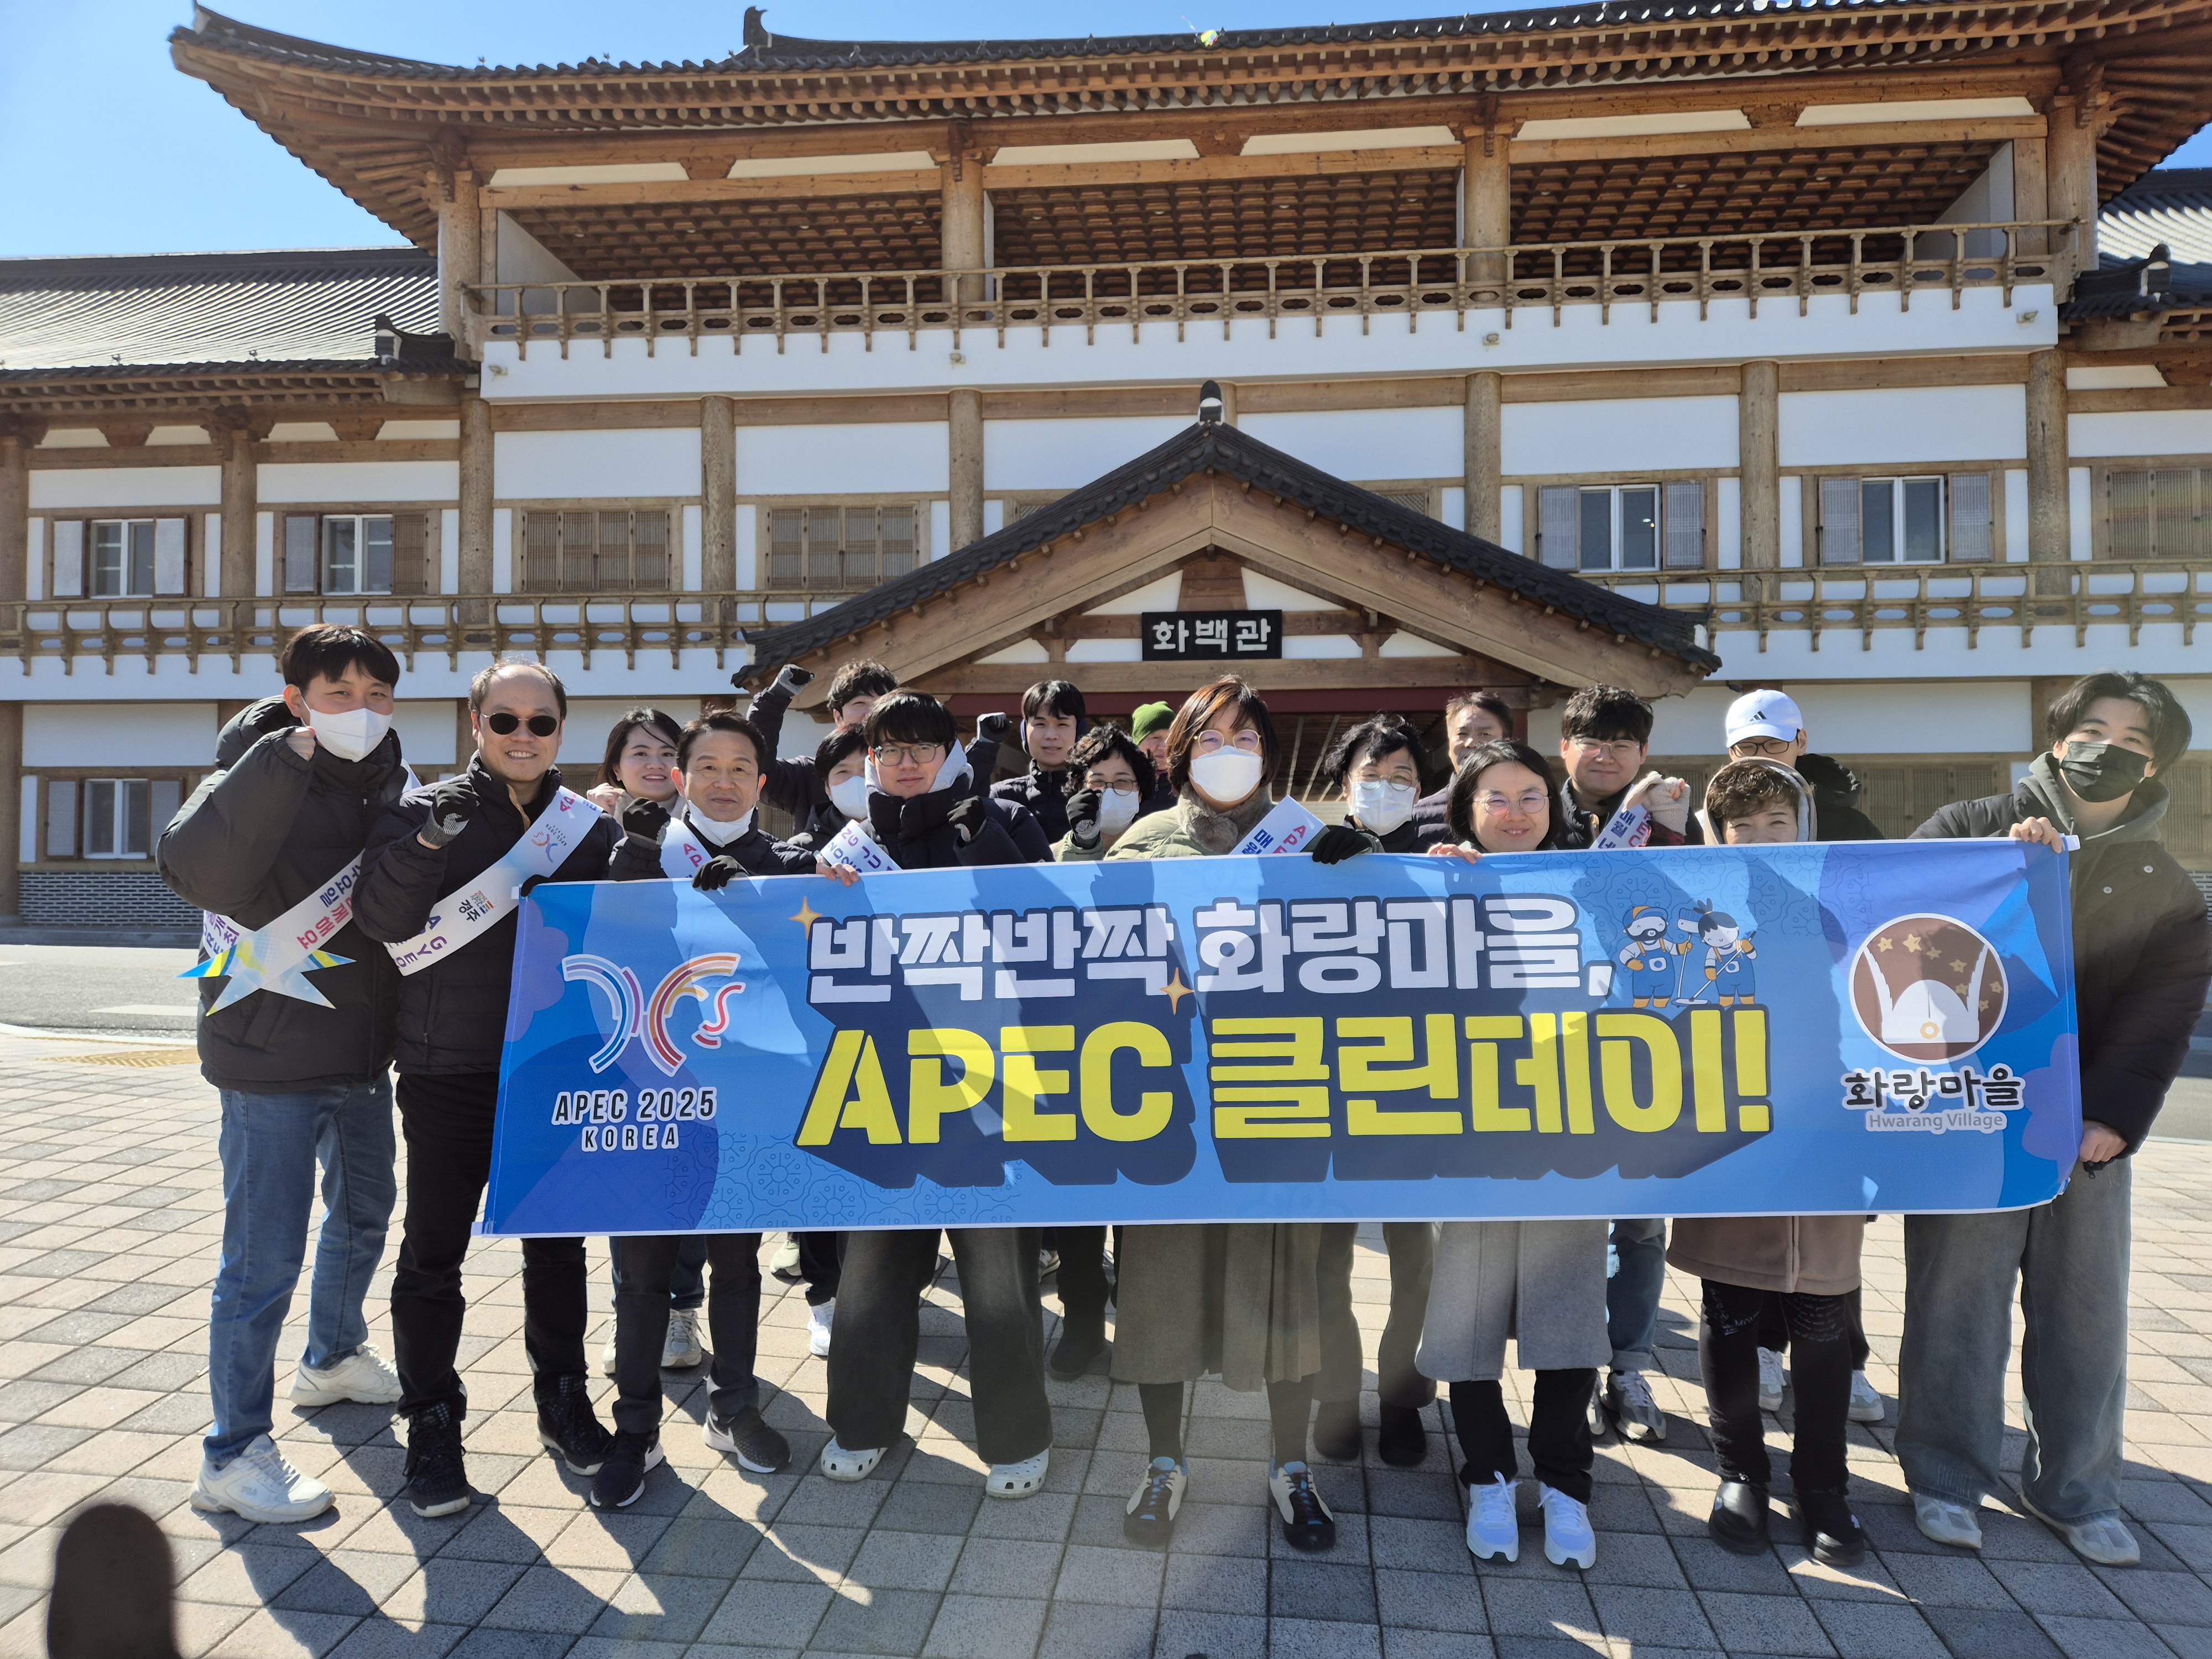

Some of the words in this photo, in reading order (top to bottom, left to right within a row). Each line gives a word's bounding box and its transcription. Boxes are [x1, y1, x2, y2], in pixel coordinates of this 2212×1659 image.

[1152, 618, 1271, 651] 화백관
[458, 899, 481, 922] 경주
[810, 907, 1173, 1004] 반짝반짝
[1197, 898, 1613, 996] 화랑마을,
[797, 1021, 1173, 1146] APEC
[1211, 1009, 1770, 1138] 클린데이!
[1845, 1067, 2022, 1110] 화랑마을
[554, 1091, 625, 1123] APEC
[639, 1088, 715, 1120] 2025
[1869, 1114, 1943, 1130] Hwarang
[1946, 1113, 2004, 1130] Village
[584, 1126, 677, 1150] KOREA
